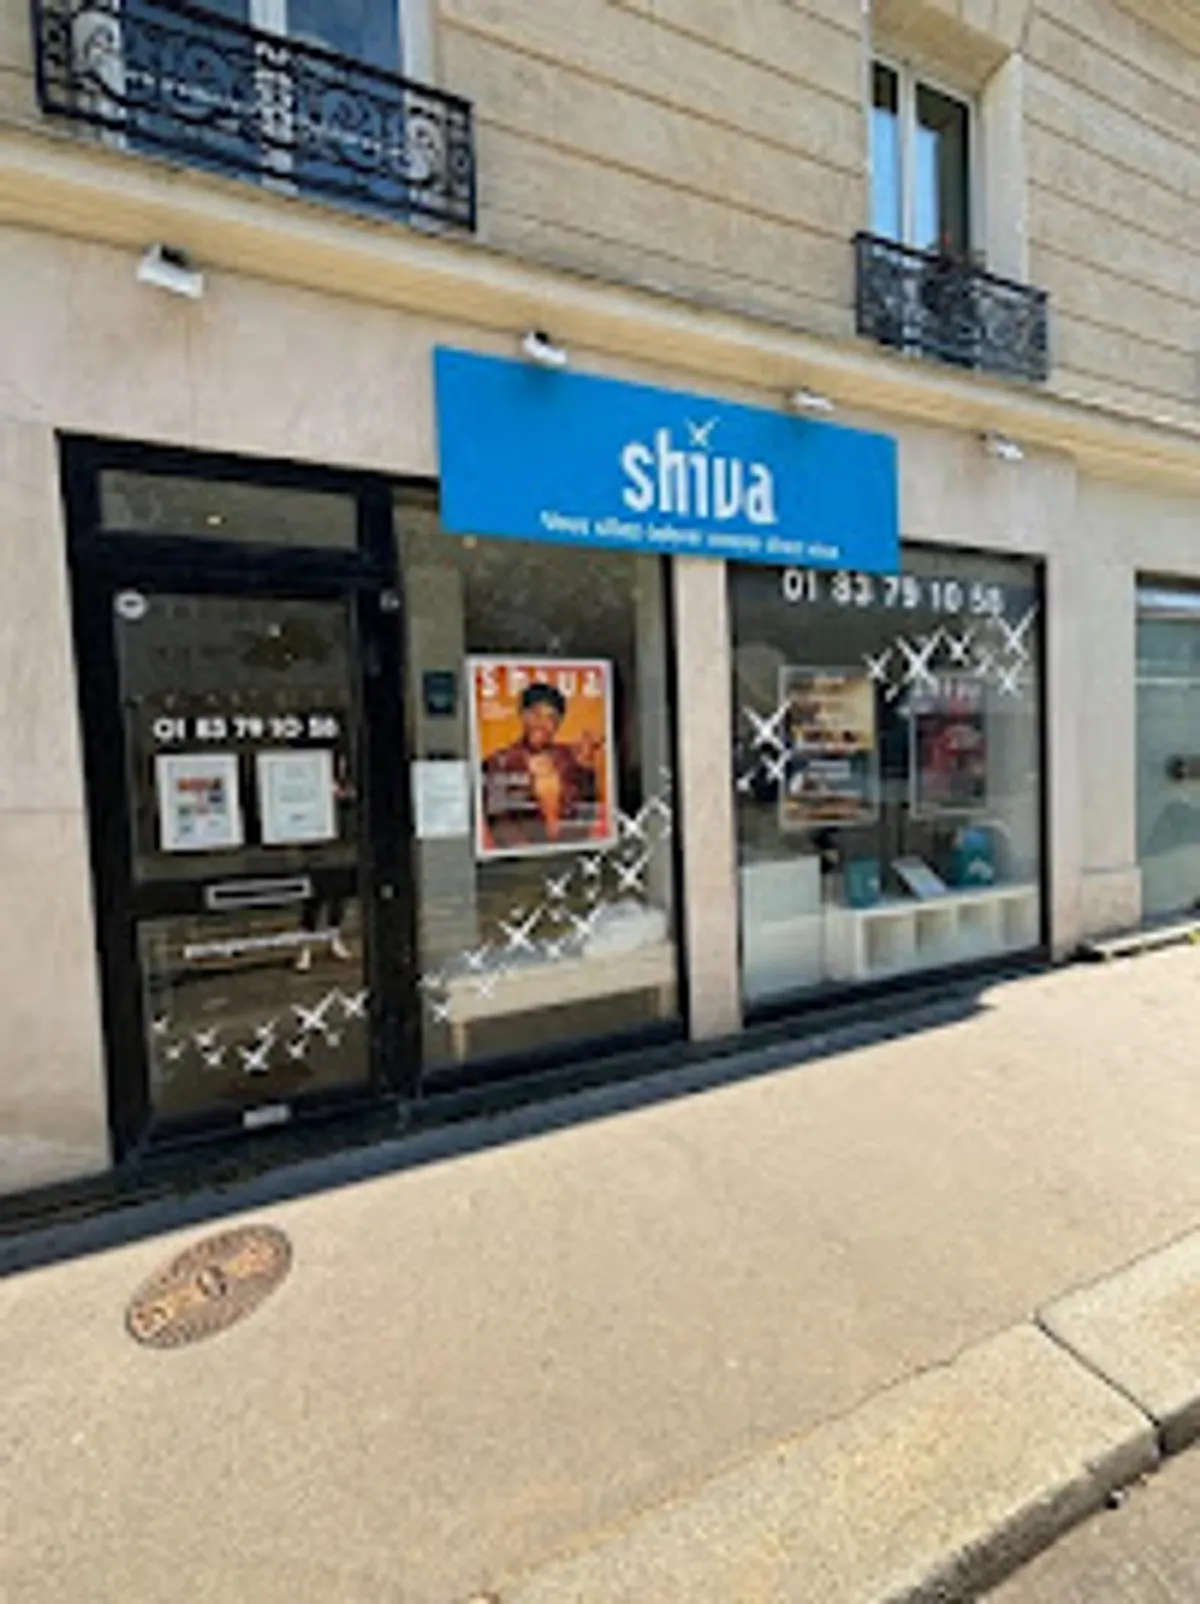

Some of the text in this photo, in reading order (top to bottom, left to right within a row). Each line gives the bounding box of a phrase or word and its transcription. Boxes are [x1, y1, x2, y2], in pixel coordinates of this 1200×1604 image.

[621, 423, 779, 525] shiva
[783, 566, 816, 603] 01
[931, 580, 965, 614] 10
[152, 716, 186, 742] 01
